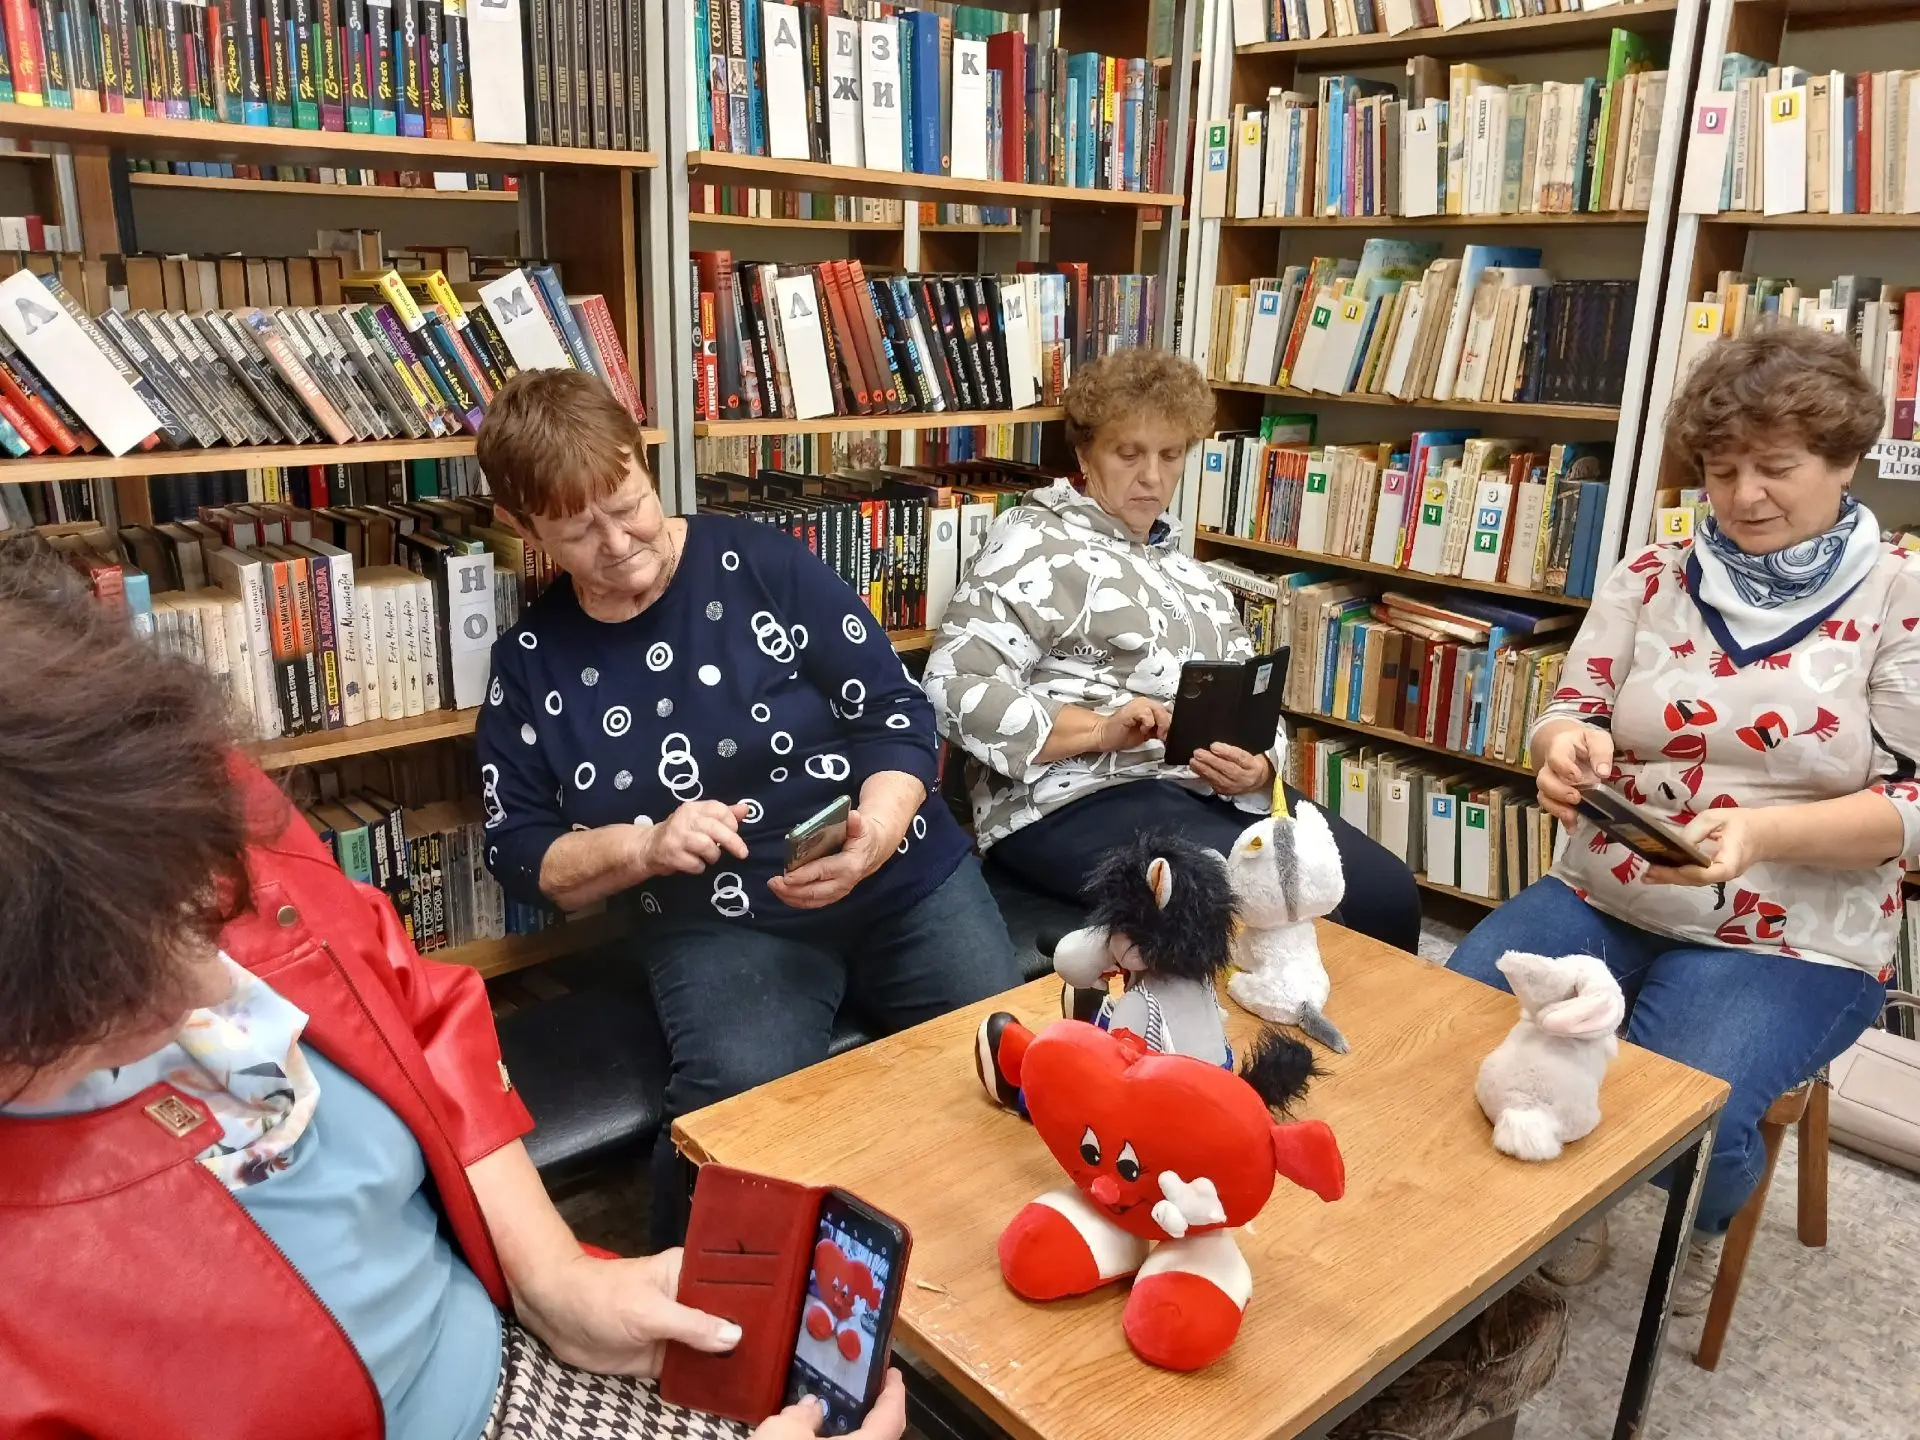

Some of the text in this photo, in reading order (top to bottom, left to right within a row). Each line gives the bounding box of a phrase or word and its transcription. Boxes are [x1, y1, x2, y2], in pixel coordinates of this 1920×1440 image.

[775, 17, 797, 48] Д
[836, 31, 852, 57] Е
[871, 34, 890, 60] З
[961, 52, 980, 75] К
[377, 61, 389, 98] Небо
[429, 67, 442, 110] Улыбка
[833, 76, 859, 101] Ж
[873, 81, 894, 108] И
[1778, 97, 1793, 117] П
[1705, 111, 1719, 129] О
[1213, 128, 1222, 143] З
[1210, 152, 1223, 167] Ж
[15, 297, 59, 336] Л
[394, 287, 417, 320] Логунова
[492, 286, 534, 325] М
[789, 292, 812, 320] Л
[1005, 296, 1023, 321] М
[1263, 297, 1274, 312] М
[1317, 308, 1327, 325] Н
[598, 303, 625, 364] МАРИНИНА
[757, 320, 765, 336] БОЯ
[1697, 312, 1709, 329] А
[75, 312, 134, 379] Литвиновы
[366, 315, 400, 361] ЛИТВИНОВЫ
[386, 317, 419, 362] ЛИТВИНОВЫ
[586, 307, 613, 368] МАРИНИНА
[760, 337, 768, 352] ТРИ
[272, 339, 319, 398] ЛИТВИНОВЫ
[706, 364, 716, 411] КОРЕЦКИЙ
[766, 380, 777, 412] ТАНКИСТ
[1868, 443, 1920, 463] тера
[1882, 460, 1920, 476] для
[1312, 476, 1321, 489] Т
[1428, 507, 1438, 522] Ч
[1482, 511, 1498, 527] Ю
[1669, 517, 1682, 532] Е
[902, 507, 910, 563] НЕЗНАНСКИЙ
[937, 520, 954, 542] О
[1480, 535, 1492, 550] Я
[460, 564, 488, 594] Н
[249, 579, 263, 632] Миленький
[298, 580, 312, 646] ОЛЬГА МИЛЕНИНА
[316, 566, 333, 634] МИХАЛЕВА
[337, 573, 355, 628] Михайлова
[278, 584, 293, 650] ОЛЬГА МИЛЕНИНА
[463, 613, 489, 640] О
[1351, 774, 1361, 789] А
[1437, 799, 1447, 813] В
[1470, 810, 1480, 824] Г
[424, 893, 432, 925] СЕРОВА
[435, 889, 443, 921] СЕРОВА
